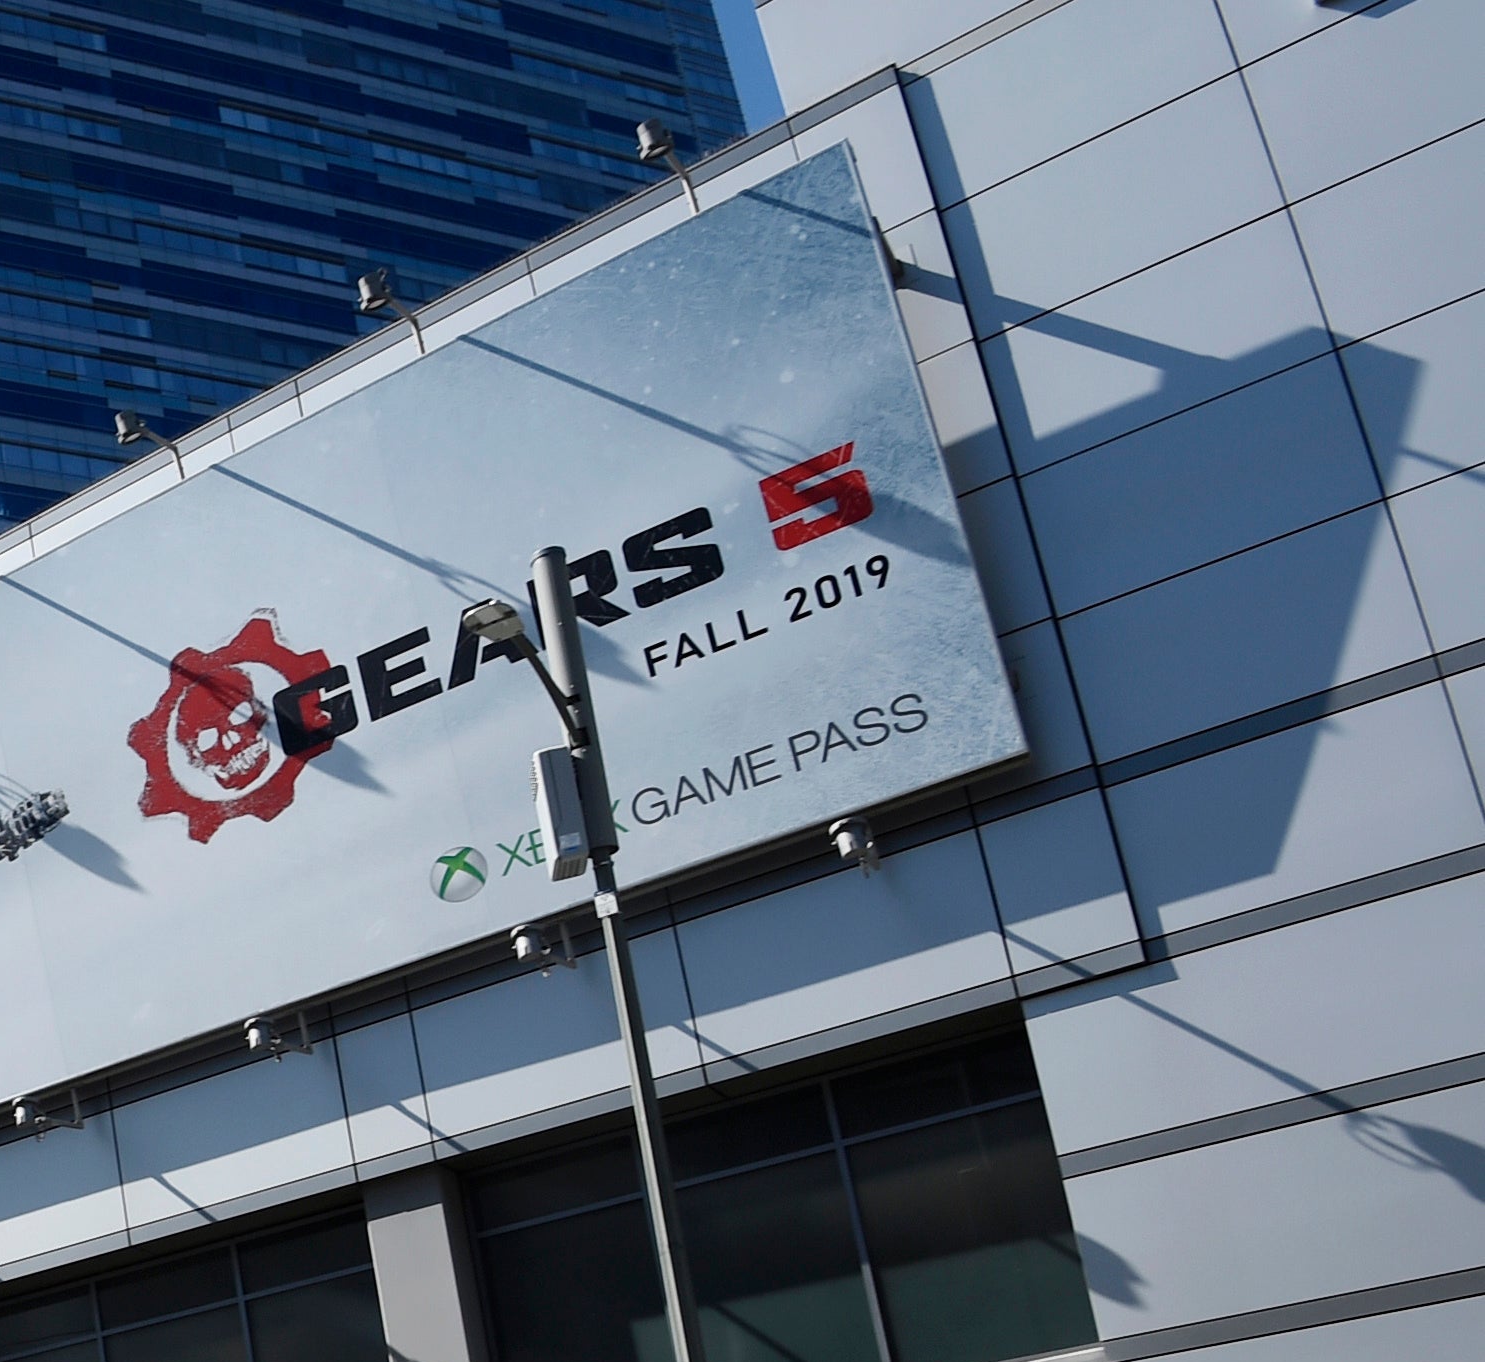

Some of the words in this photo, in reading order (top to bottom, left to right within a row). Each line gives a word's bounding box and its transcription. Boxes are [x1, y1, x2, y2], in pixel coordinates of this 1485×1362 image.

[273, 506, 724, 756] GEARS
[759, 441, 875, 551] 5
[643, 607, 769, 678] FALL
[784, 553, 890, 622] 2019
[630, 742, 782, 825] GAME
[786, 692, 930, 777] PASS
